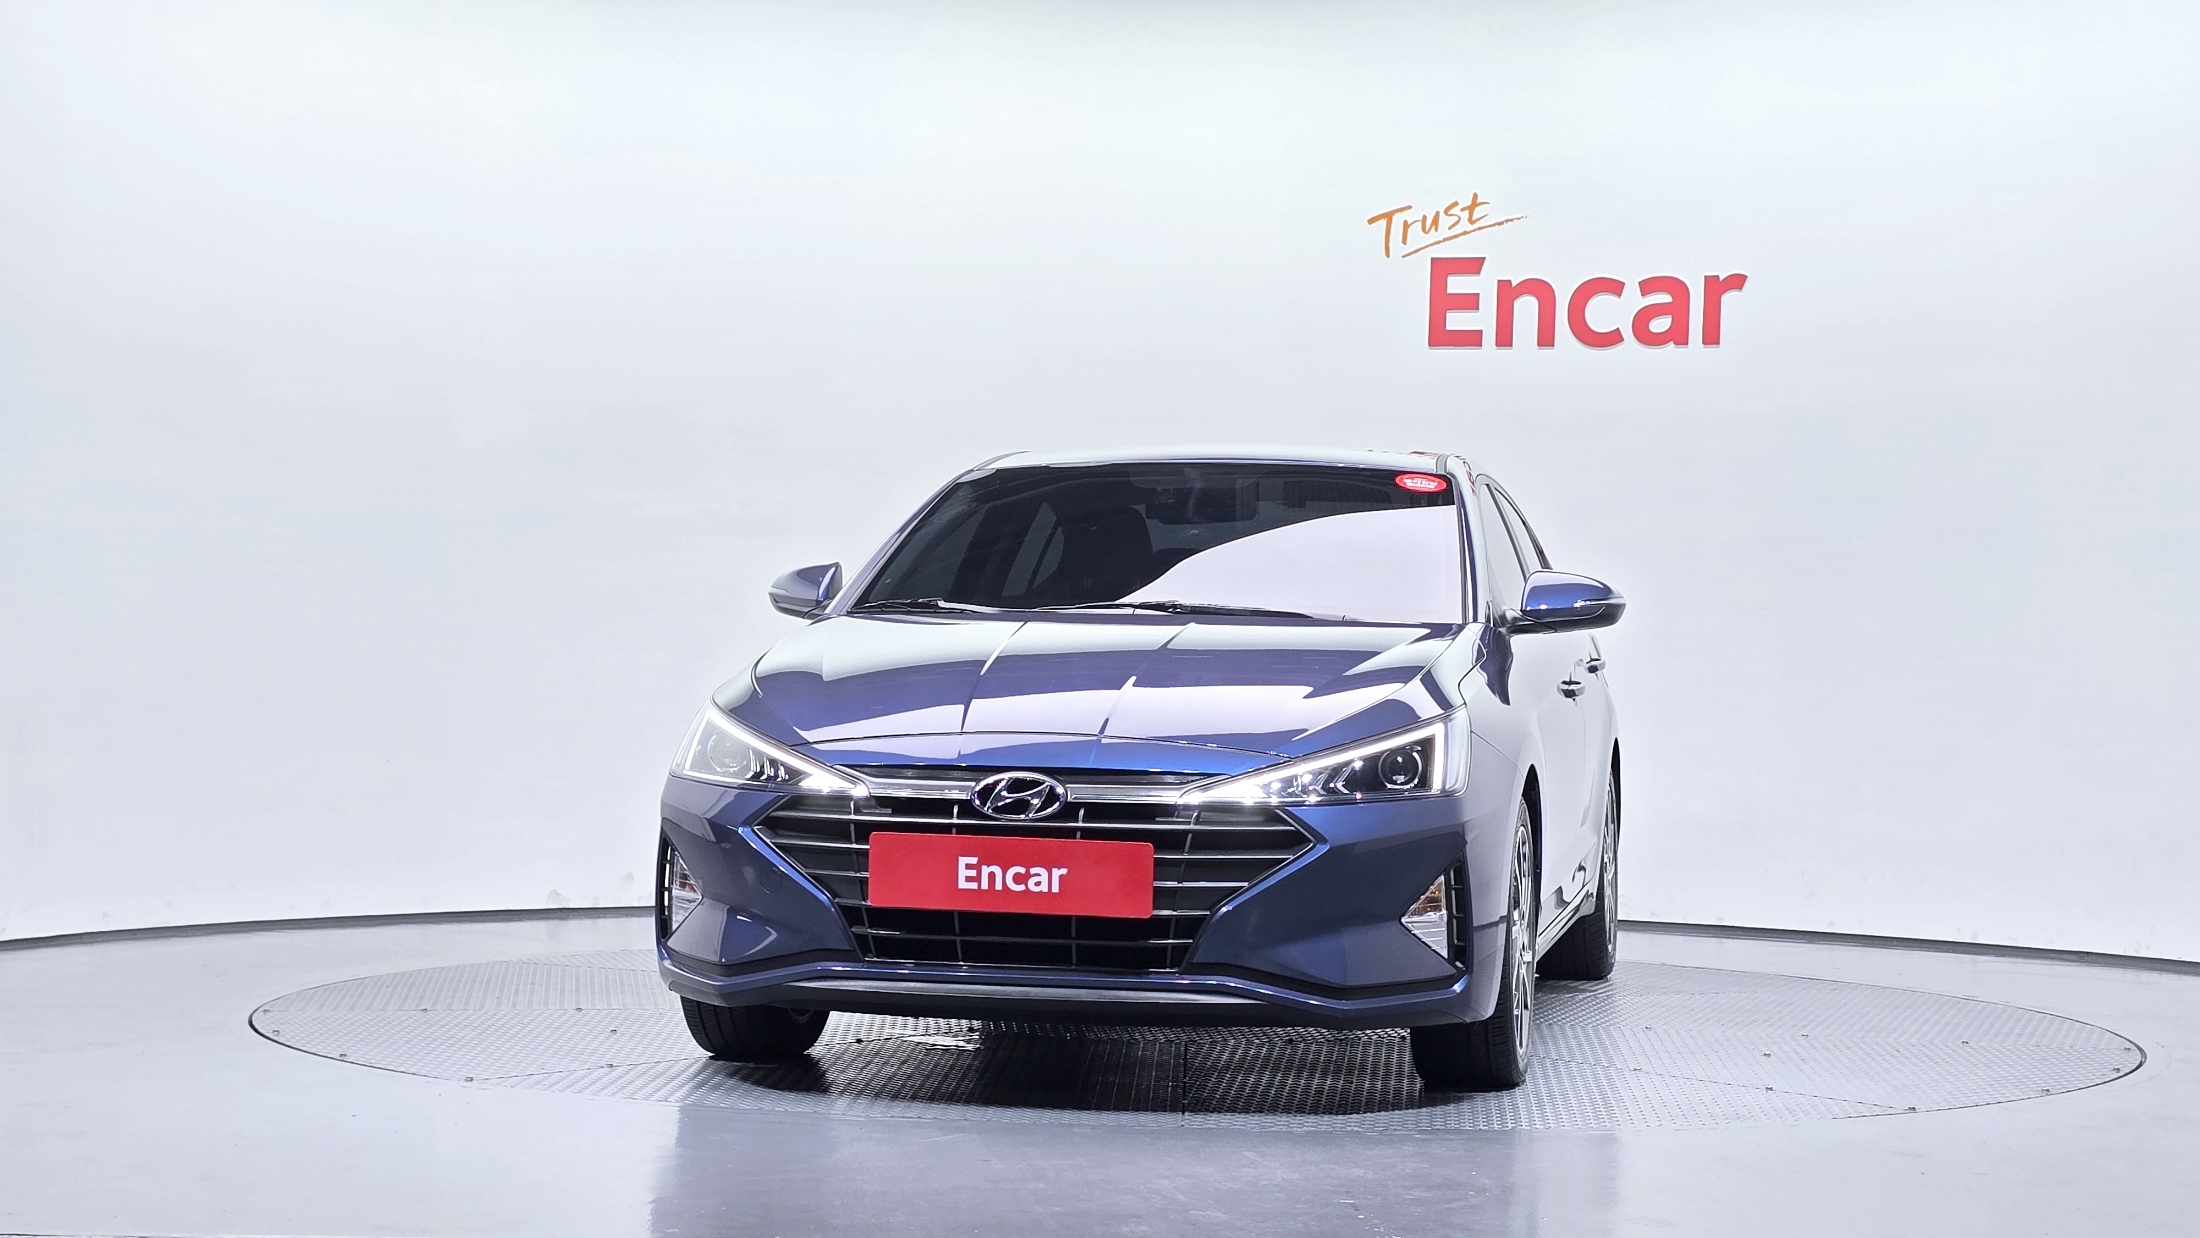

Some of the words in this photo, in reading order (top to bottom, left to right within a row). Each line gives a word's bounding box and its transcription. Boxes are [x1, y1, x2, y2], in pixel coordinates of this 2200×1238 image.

[1367, 192, 1490, 258] Trust
[1428, 257, 1748, 349] Encar
[958, 856, 1068, 893] Encar
